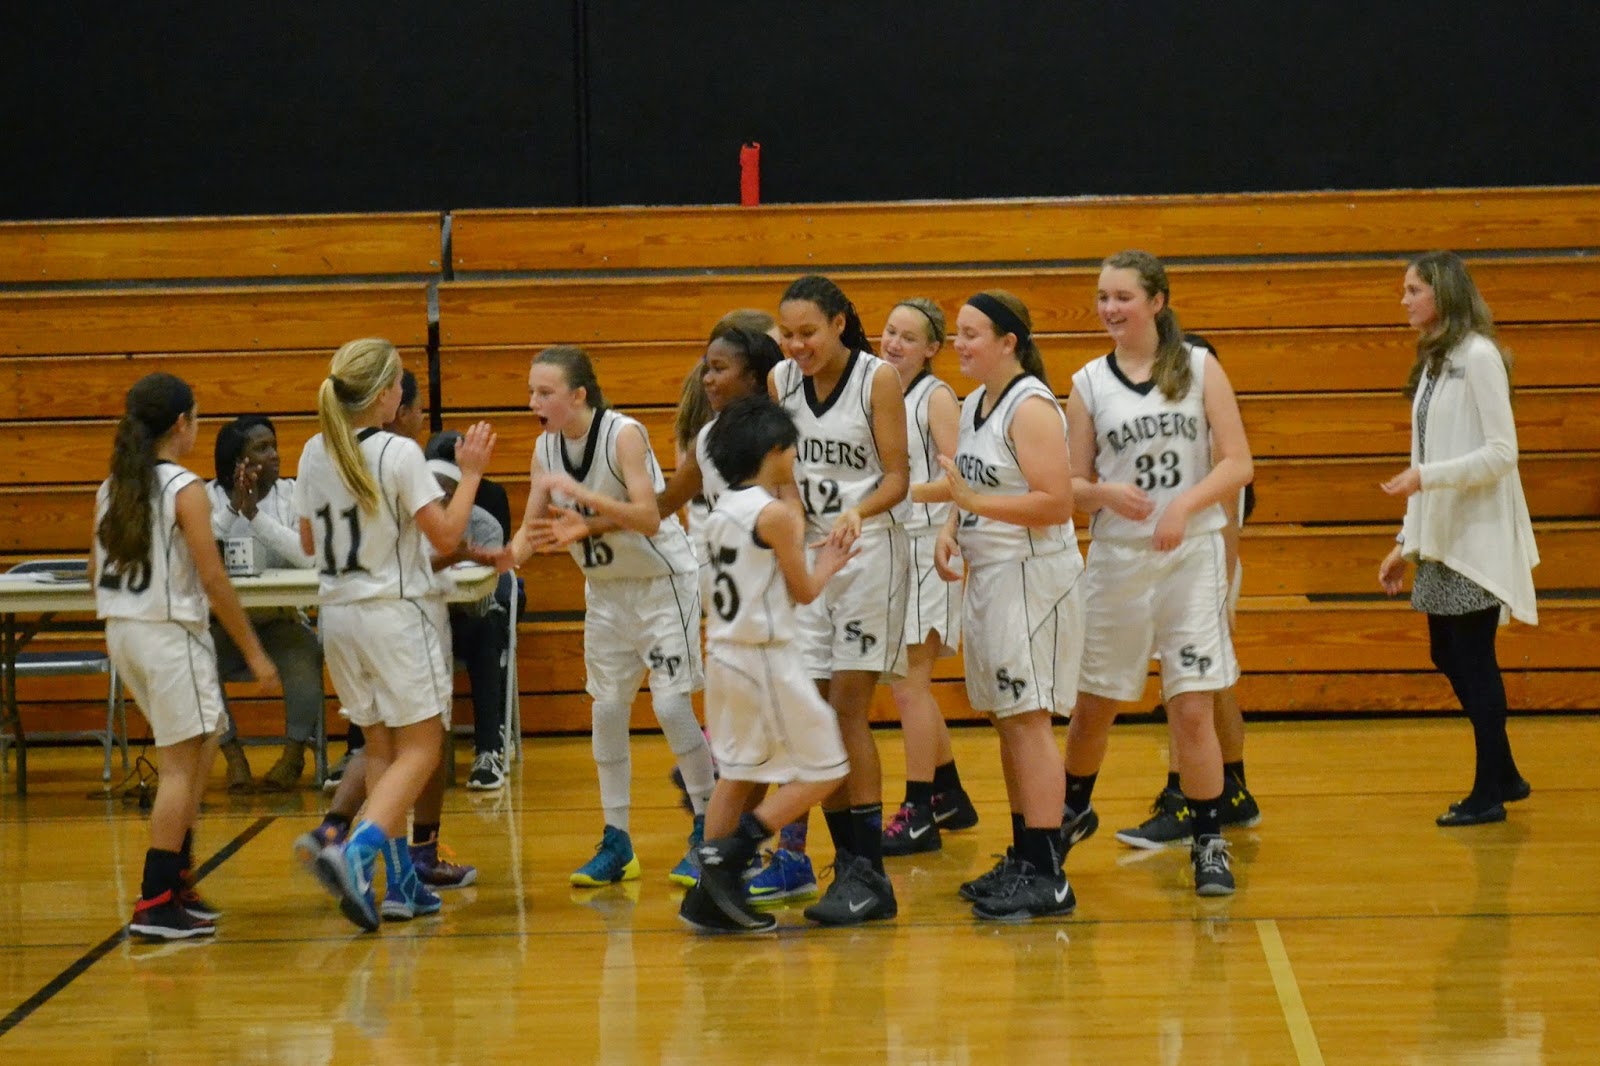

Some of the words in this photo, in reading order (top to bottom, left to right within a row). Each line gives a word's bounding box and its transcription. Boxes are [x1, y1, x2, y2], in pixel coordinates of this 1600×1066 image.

[1107, 412, 1198, 453] RAIDERS
[797, 438, 867, 470] IDERS
[1135, 451, 1181, 491] 33
[801, 479, 842, 515] 12
[317, 503, 371, 576] 11
[844, 620, 877, 657] SP
[649, 646, 682, 679] SP
[1180, 644, 1212, 678] SP
[996, 667, 1027, 702] SP
